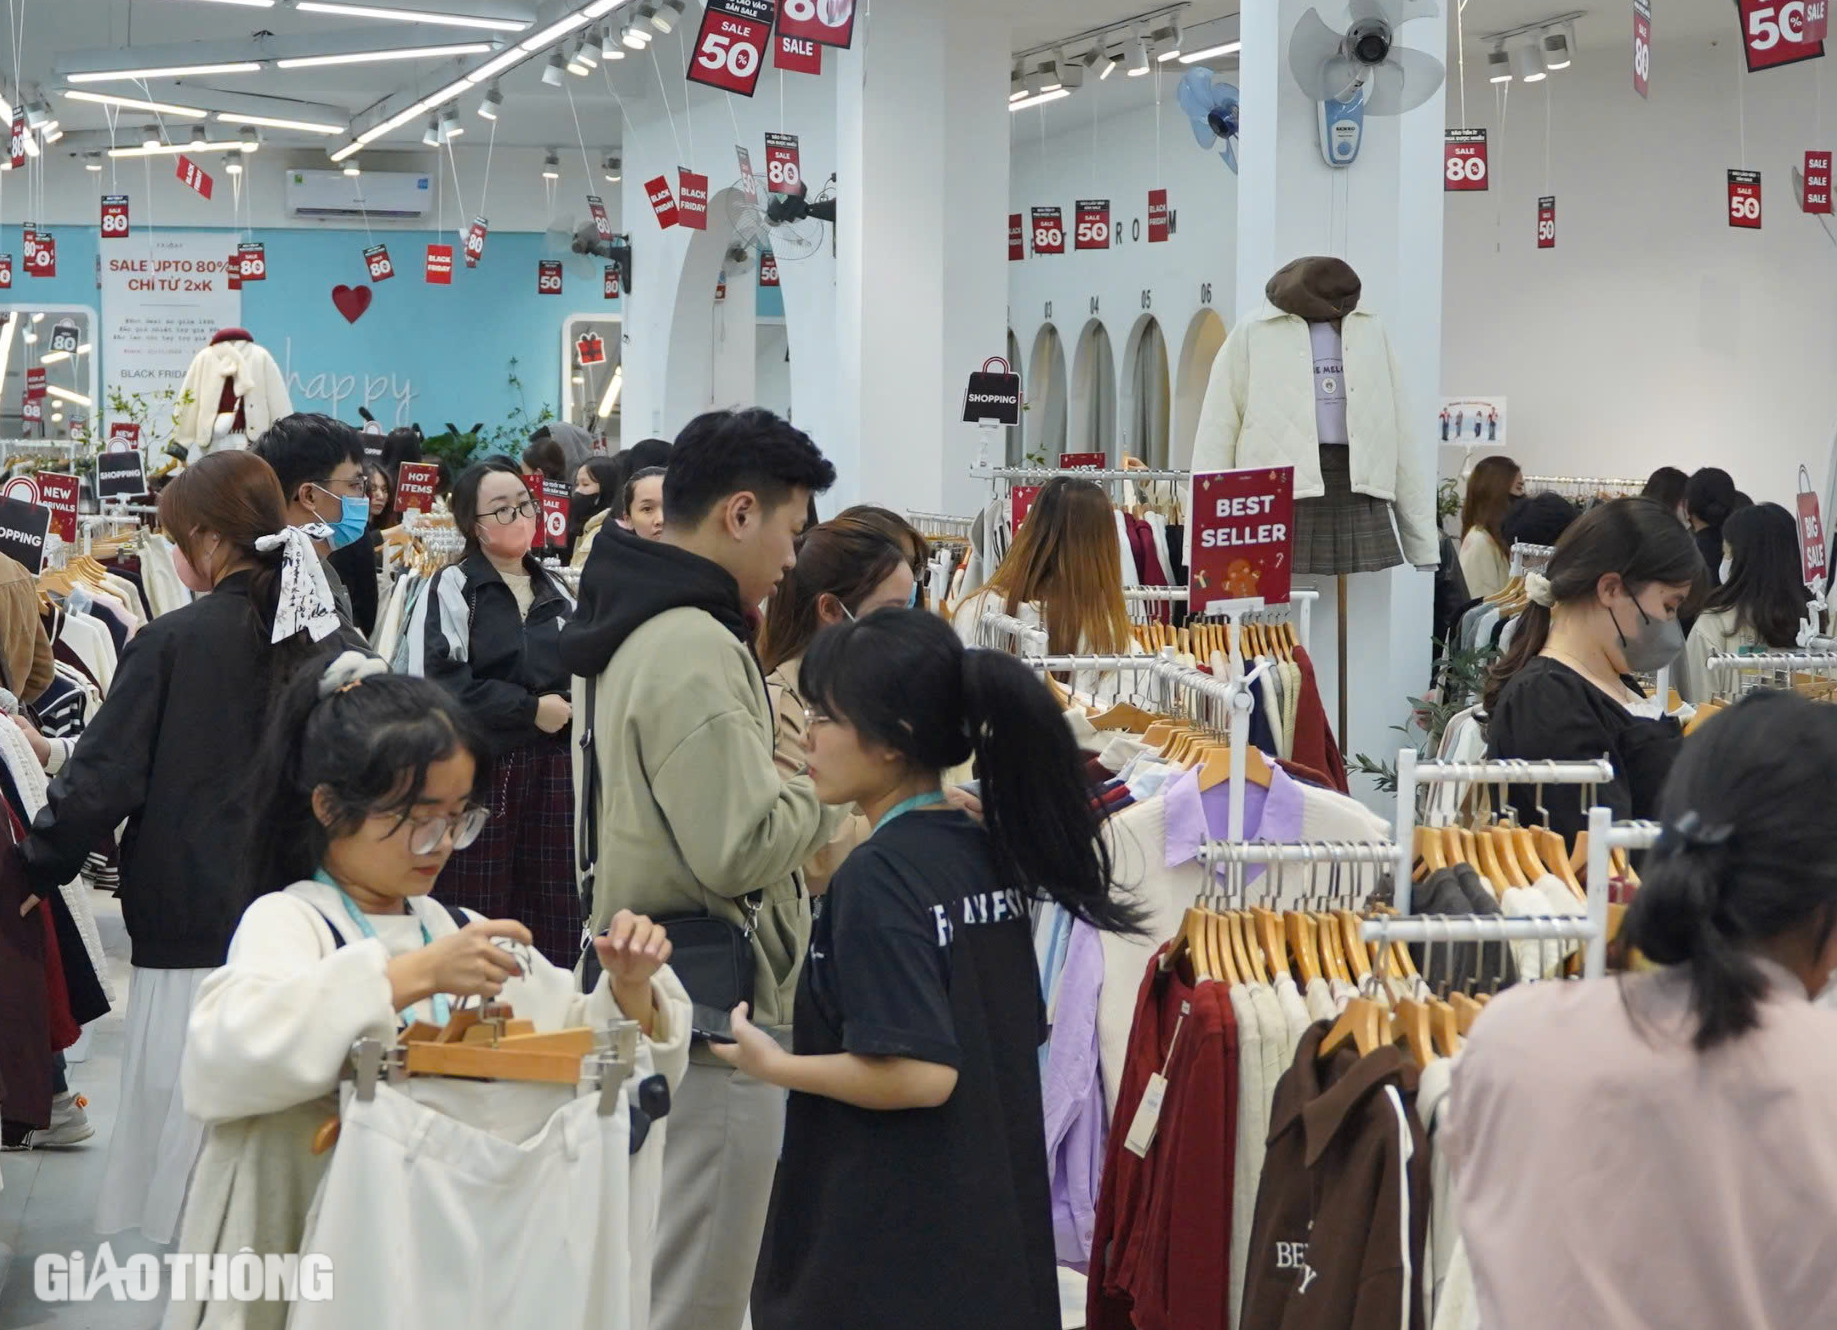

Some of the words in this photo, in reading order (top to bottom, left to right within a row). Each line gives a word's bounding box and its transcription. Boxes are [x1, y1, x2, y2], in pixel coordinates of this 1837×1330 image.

[740, 7, 758, 17] SALE
[1807, 2, 1825, 22] SALE
[721, 21, 751, 37] SALE
[783, 37, 813, 56] SALE
[775, 152, 791, 160] SALE
[1808, 159, 1828, 169] SALE
[1808, 176, 1828, 187] SALE
[680, 187, 706, 199] BLACK
[1807, 194, 1827, 204] SALE
[680, 200, 706, 213] FRIDAY
[110, 260, 148, 272] SALE
[184, 279, 212, 291] 2xK
[1141, 289, 1151, 309] 05
[1201, 283, 1212, 304] 06
[1090, 296, 1099, 315] 04
[121, 370, 156, 378] BLACK
[158, 370, 189, 378] FRIDA
[968, 394, 1017, 404] SHOPPING
[100, 469, 141, 480] SHOPPING
[408, 472, 430, 482] HOT
[43, 486, 72, 499] NEW
[401, 484, 432, 493] ITEMS
[1216, 495, 1275, 517] BEST
[1804, 516, 1818, 539] BIG
[1201, 523, 1286, 547] SELLER
[1806, 543, 1825, 567] SALE
